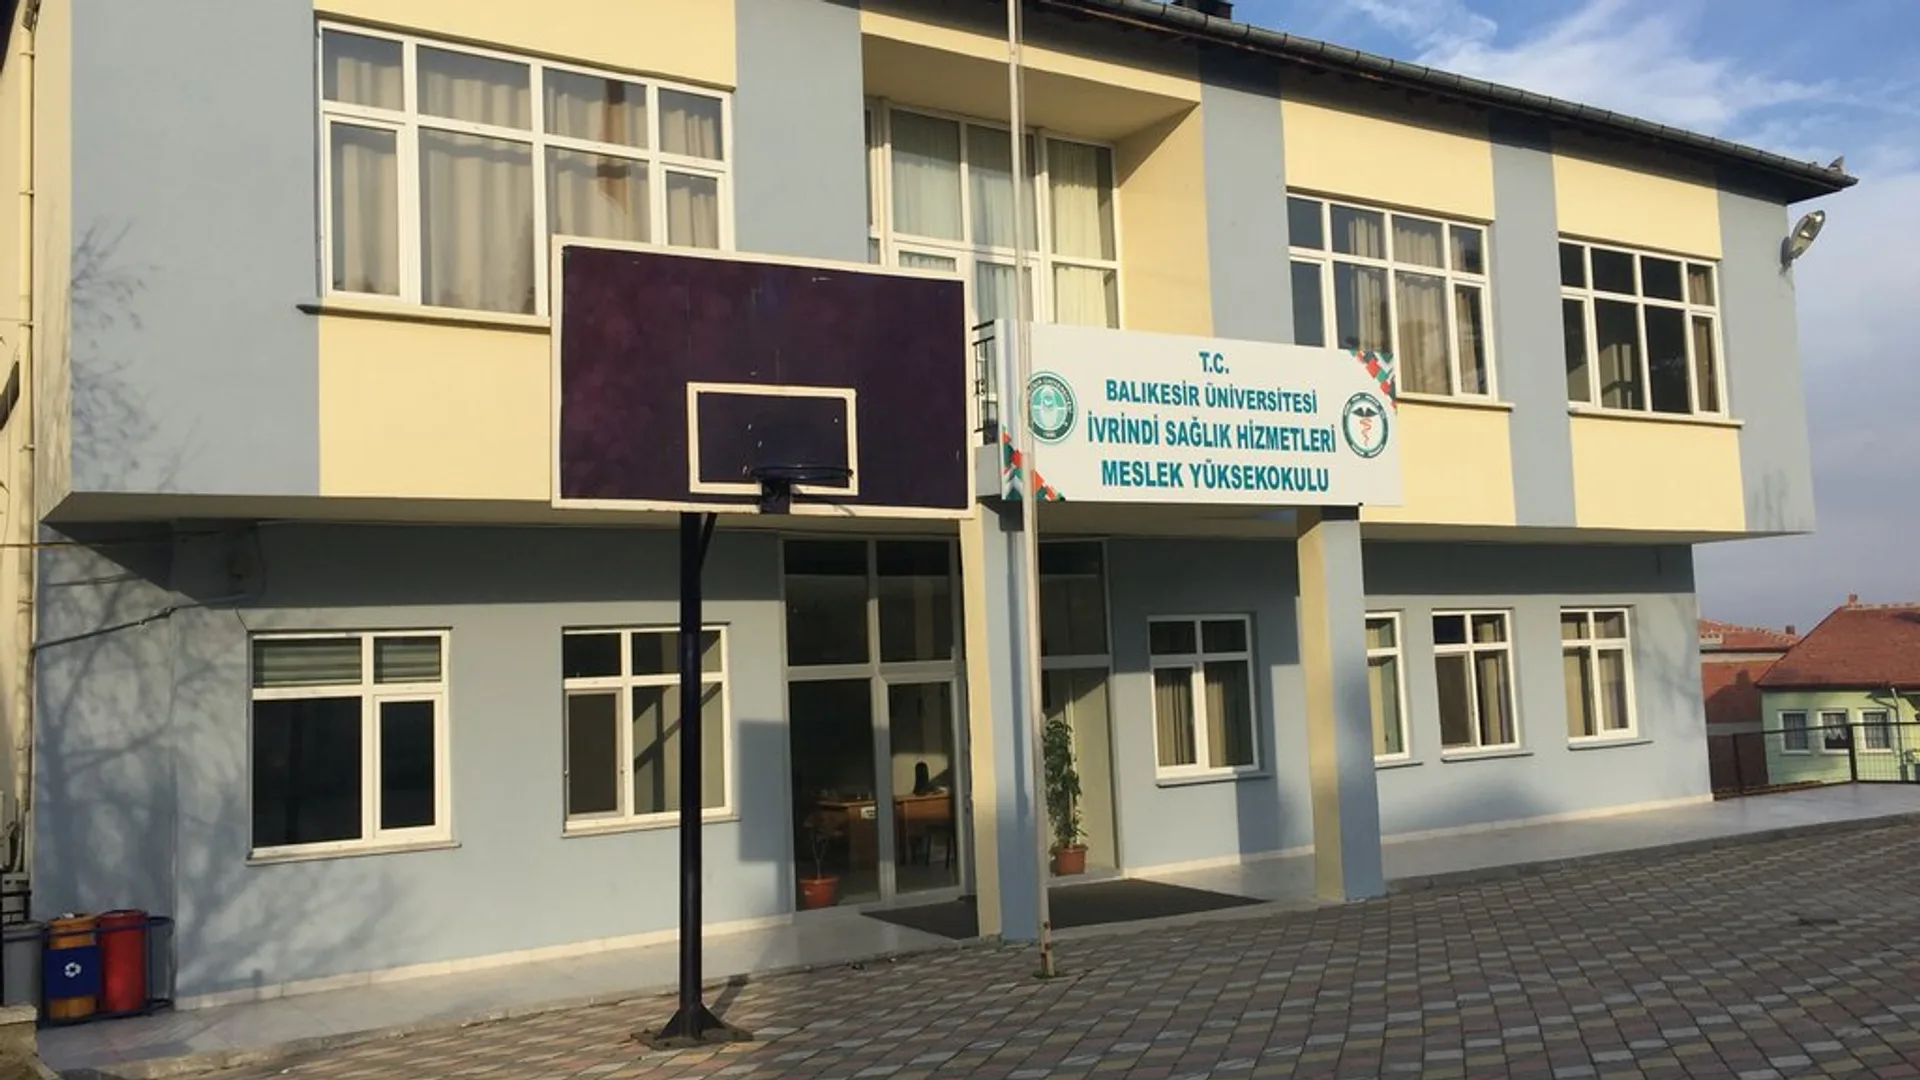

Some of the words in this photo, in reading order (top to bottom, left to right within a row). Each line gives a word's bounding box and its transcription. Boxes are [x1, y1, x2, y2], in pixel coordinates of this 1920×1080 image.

[1199, 351, 1230, 375] T.C.
[1106, 379, 1200, 406] BALIKESİR
[1205, 382, 1318, 414] ÜNİVERSİTESİ
[1087, 410, 1161, 445] İVRİNDİ
[1165, 416, 1233, 450] SAĞLIK
[1237, 419, 1337, 453] HİZMETLERİ
[1101, 460, 1184, 488] MESLEK
[1189, 459, 1329, 493] YÜKSEKOKULU
